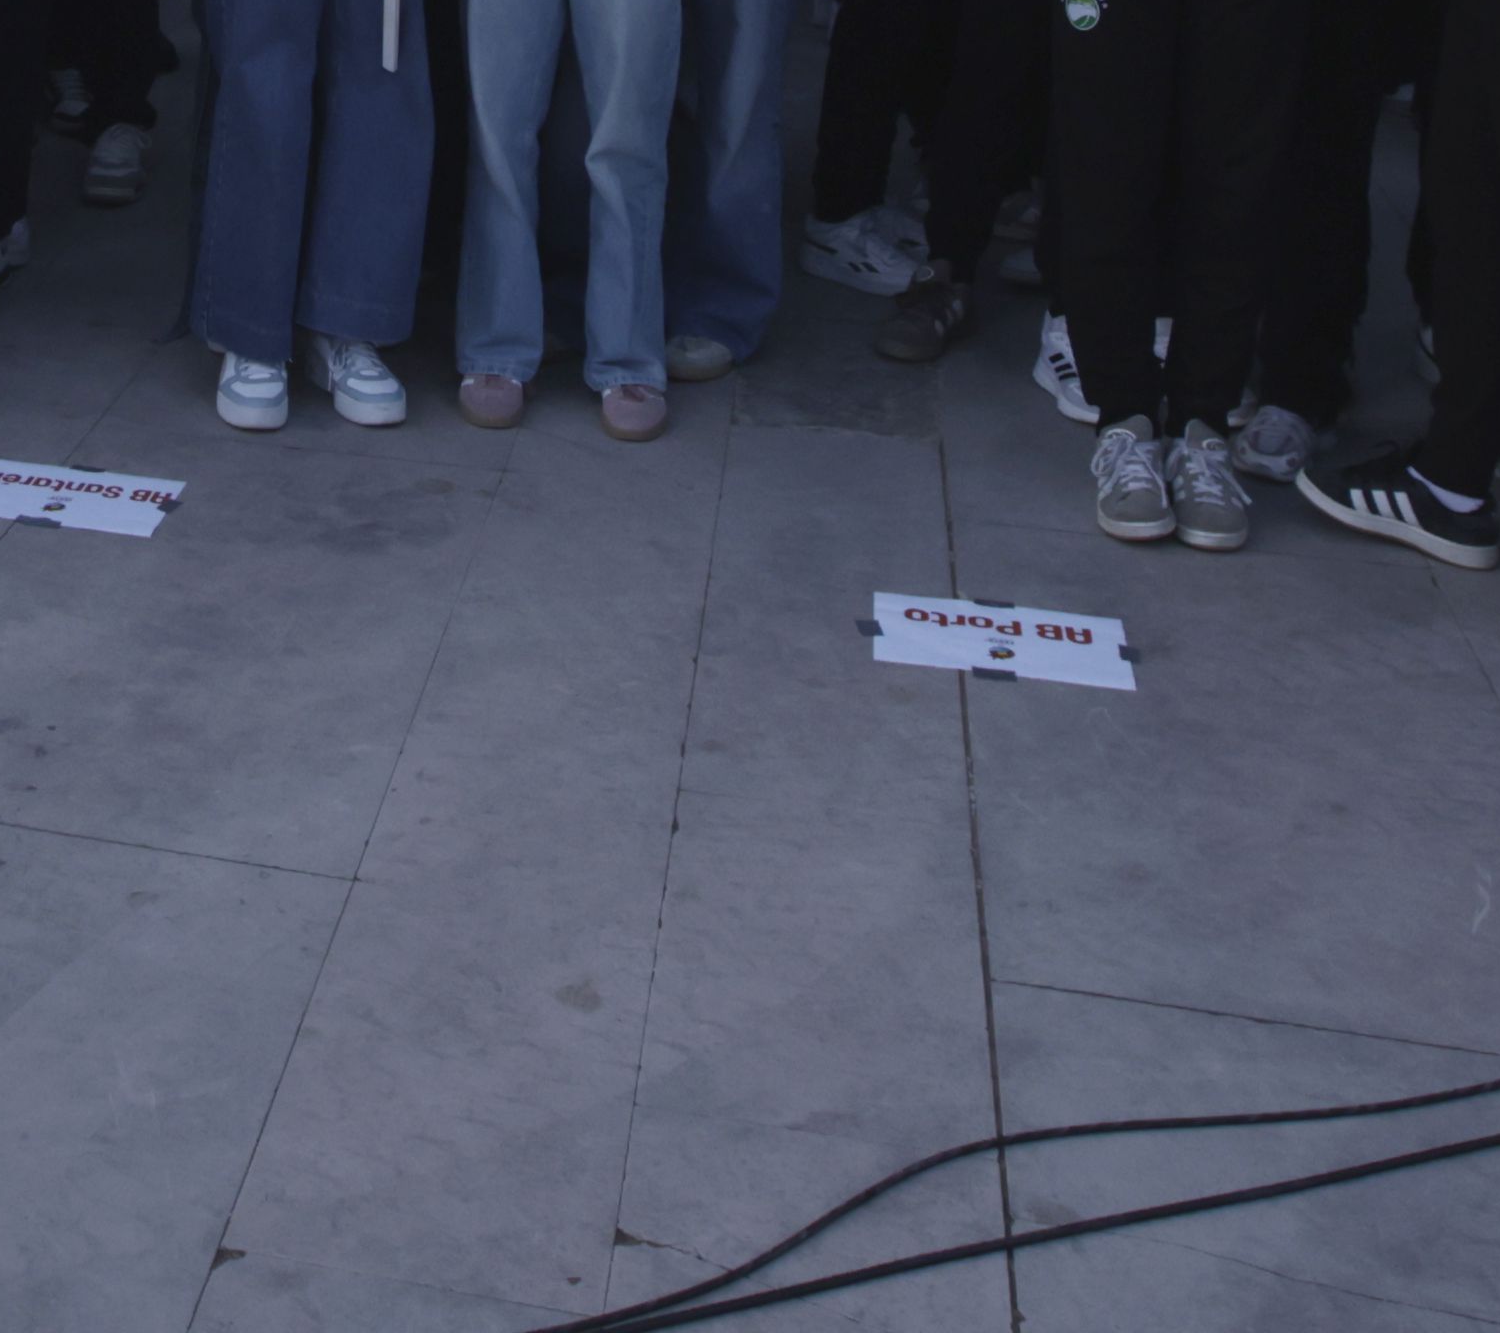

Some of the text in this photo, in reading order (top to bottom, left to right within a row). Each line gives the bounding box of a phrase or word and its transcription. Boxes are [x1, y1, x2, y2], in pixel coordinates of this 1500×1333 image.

[129, 489, 174, 505] AB
[904, 607, 1093, 645] AB Porto
